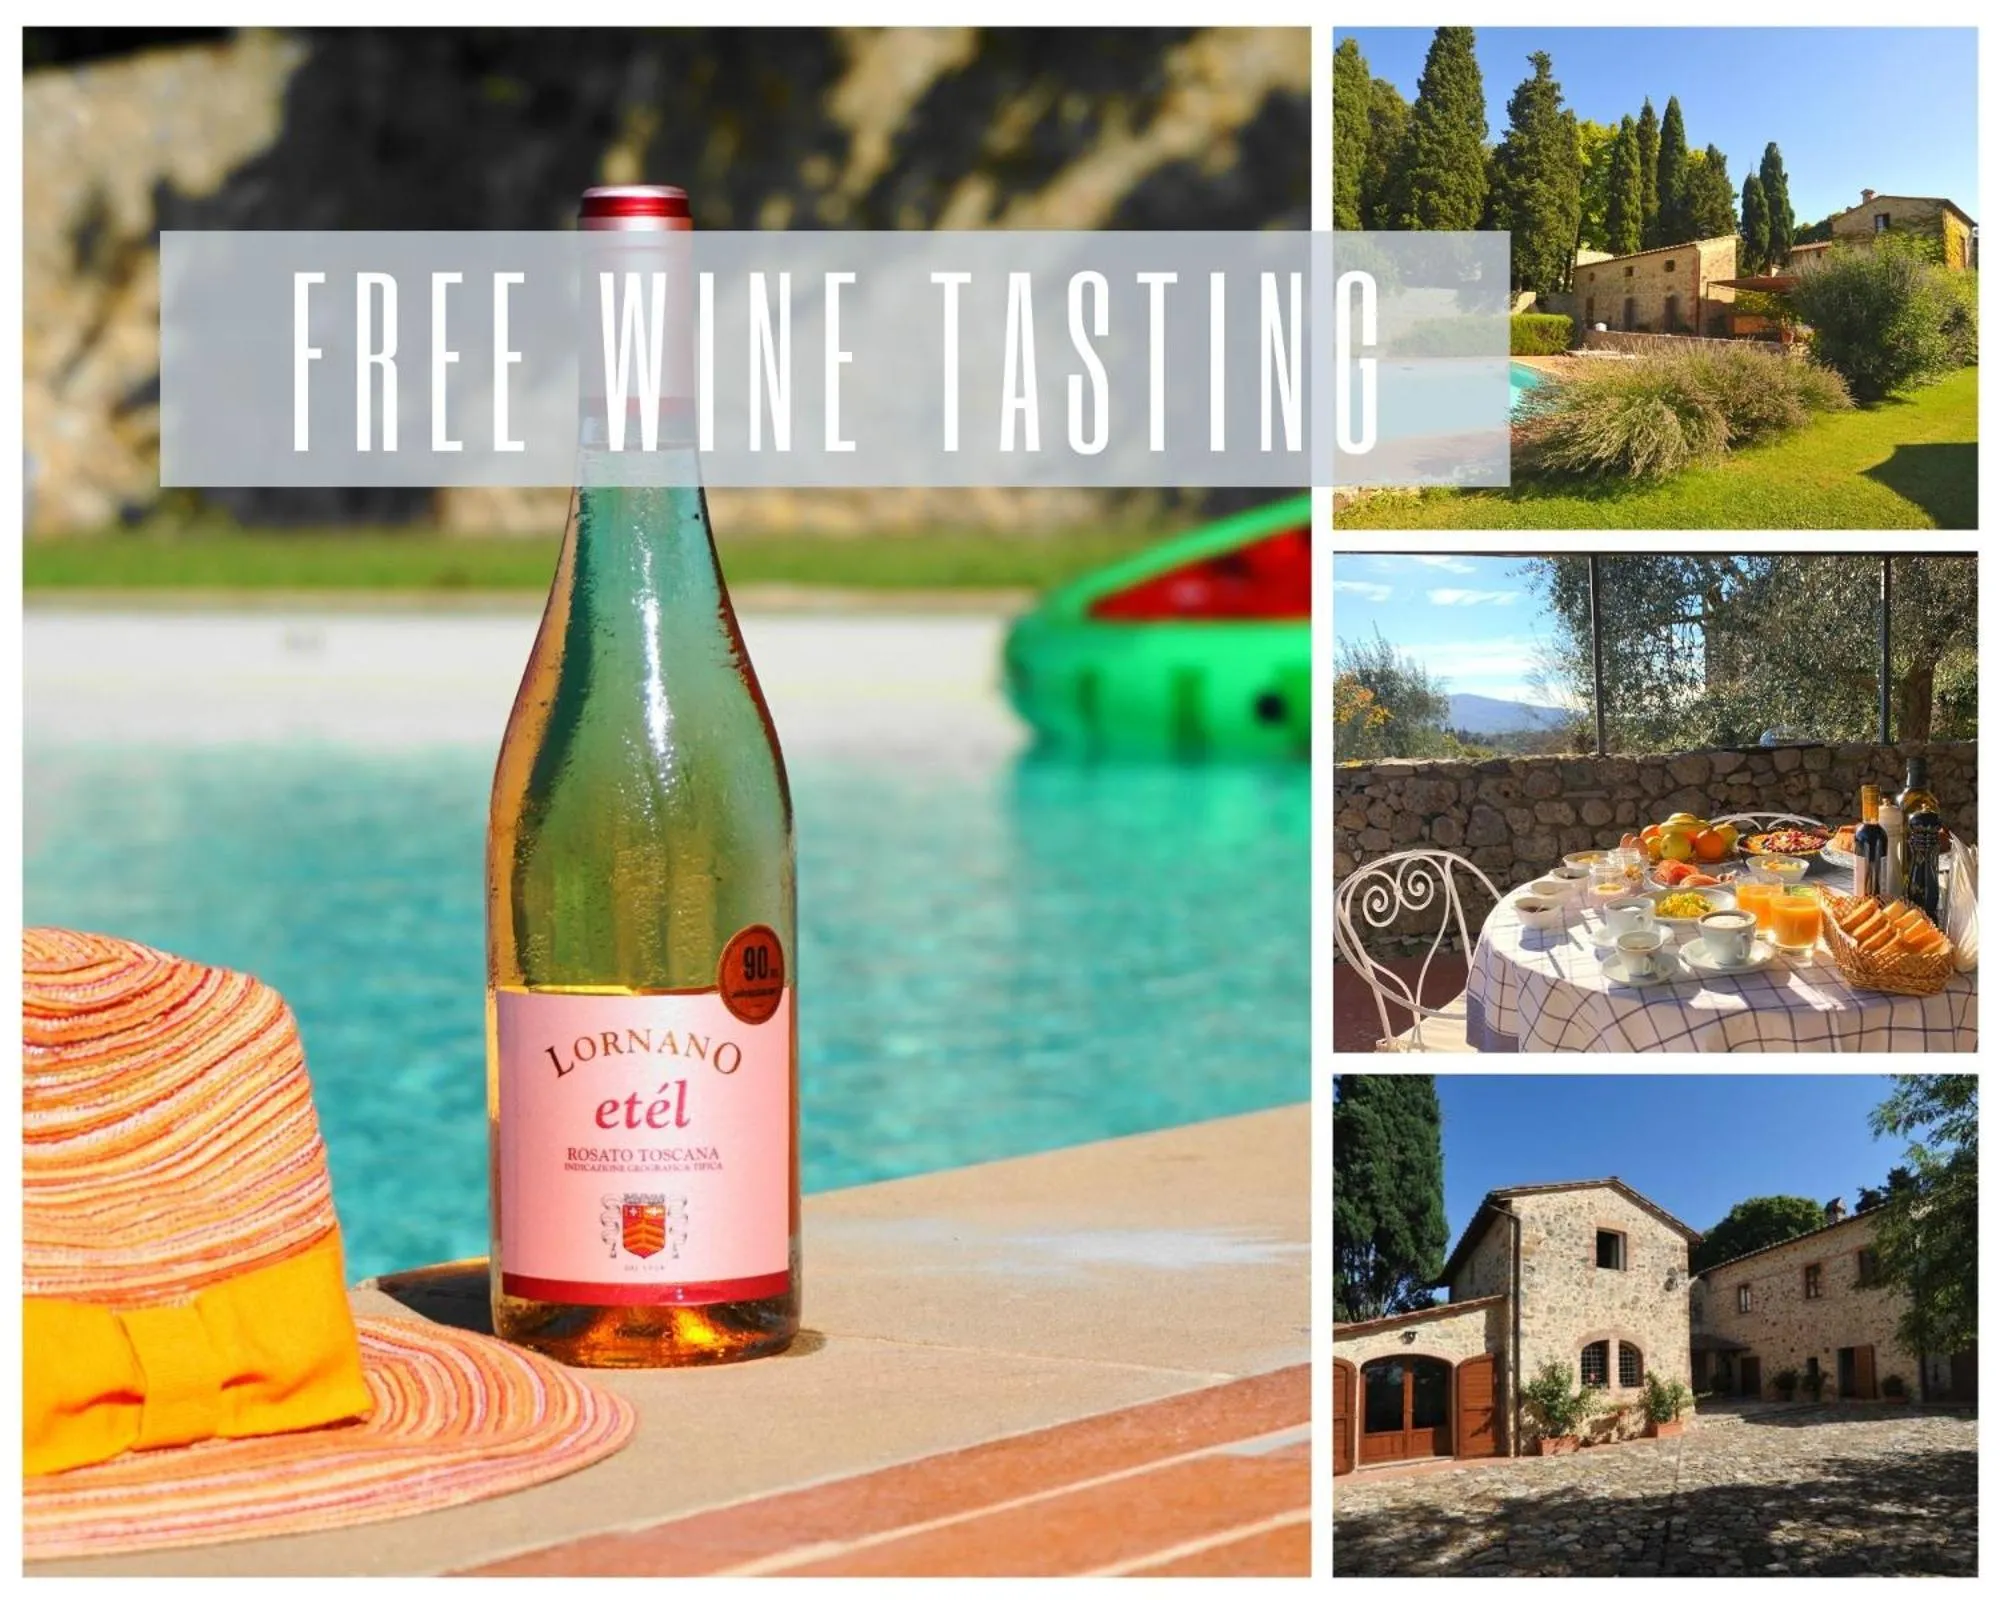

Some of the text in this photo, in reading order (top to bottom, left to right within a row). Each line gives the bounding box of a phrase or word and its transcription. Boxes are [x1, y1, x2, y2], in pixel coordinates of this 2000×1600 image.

[744, 946, 768, 981] 90
[545, 1029, 742, 1078] LORNANO
[595, 1079, 691, 1129] etél
[567, 1147, 720, 1162] ROSATO TOSCANA
